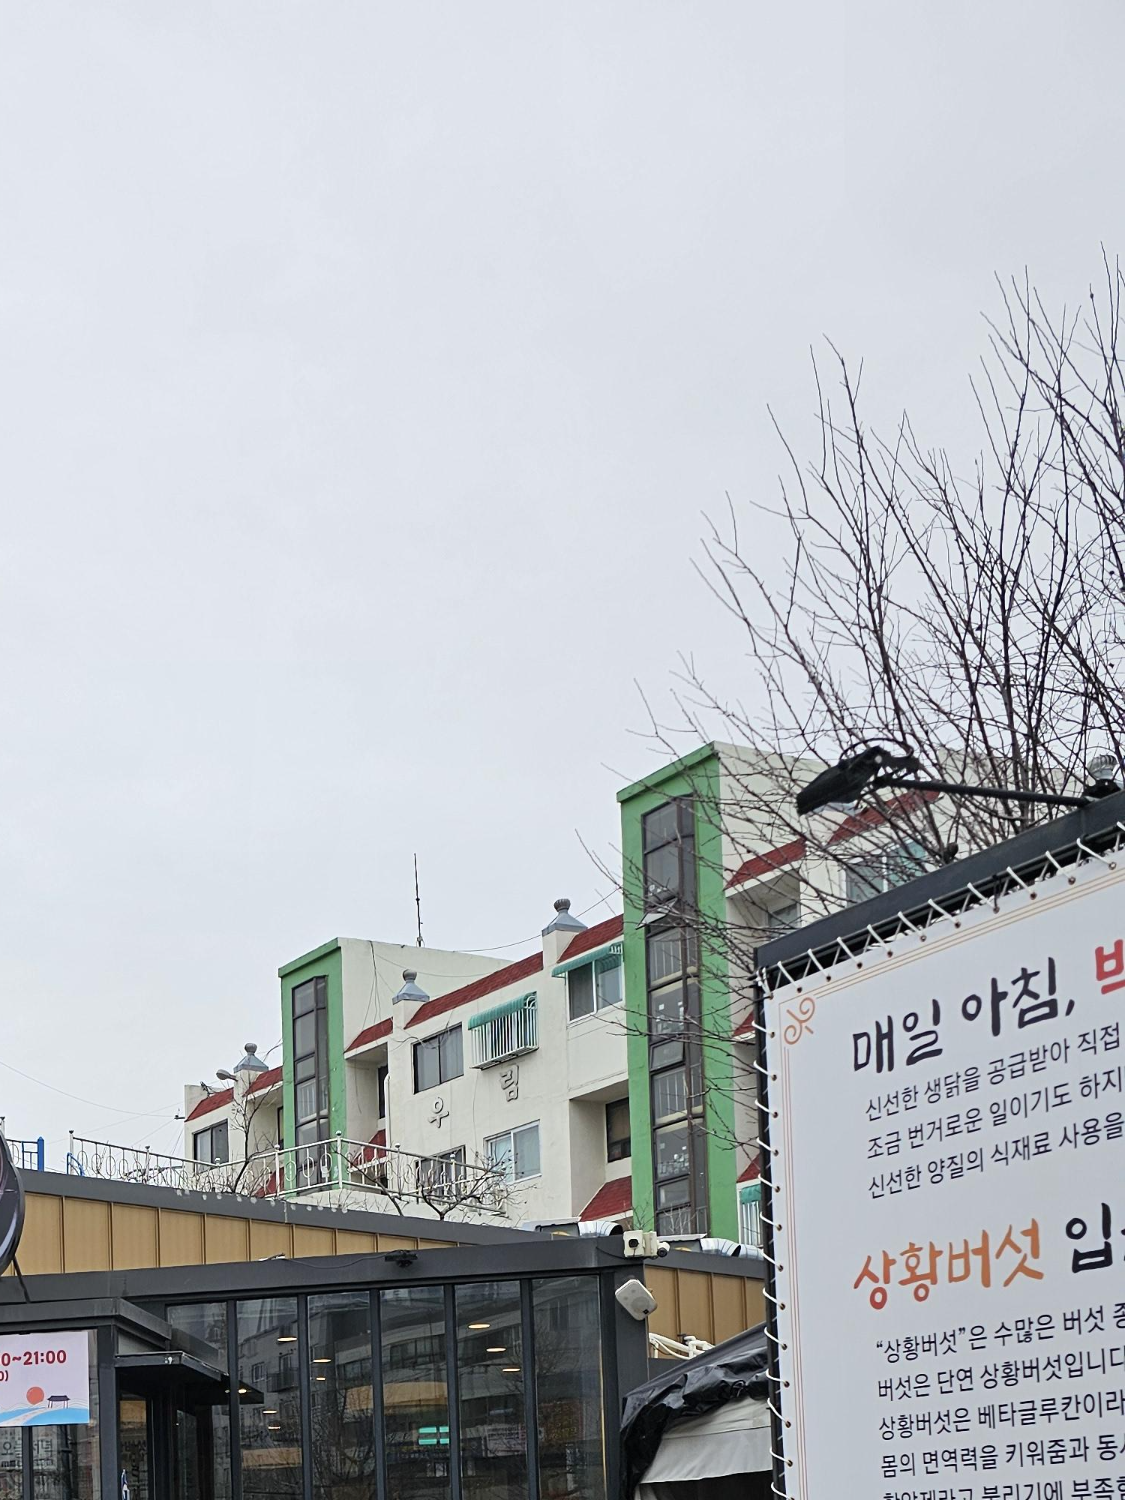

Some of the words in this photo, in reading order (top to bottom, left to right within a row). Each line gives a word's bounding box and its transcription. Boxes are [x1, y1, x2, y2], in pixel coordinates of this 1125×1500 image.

[852, 999, 943, 1073] 매일
[961, 957, 1075, 1036] 아침,
[865, 1085, 918, 1122] 신선한
[924, 1066, 981, 1104] 생닭을
[987, 1038, 1070, 1086] 공급받아
[1077, 1022, 1121, 1055] 직접
[867, 1131, 902, 1159] 조금
[908, 1107, 983, 1150] 번거로운
[989, 1082, 1072, 1127] 일이기도
[868, 1164, 922, 1199] 신선한
[927, 1147, 984, 1184] 양질의
[990, 1131, 1052, 1166] 식재료
[1059, 1111, 1125, 1149] 사용을
[853, 1217, 1044, 1310] 상황버섯
[993, 1314, 1055, 1346] 수많은
[1062, 1305, 1105, 1335] 버섯
[878, 1373, 930, 1401] 버섯은
[937, 1366, 974, 1394] 단연
[879, 1407, 971, 1440] 상황버섯은
[881, 1452, 916, 1478] 몸의
[923, 1444, 999, 1475] 면역력을
[1005, 1435, 1090, 1468] 키워줌과
